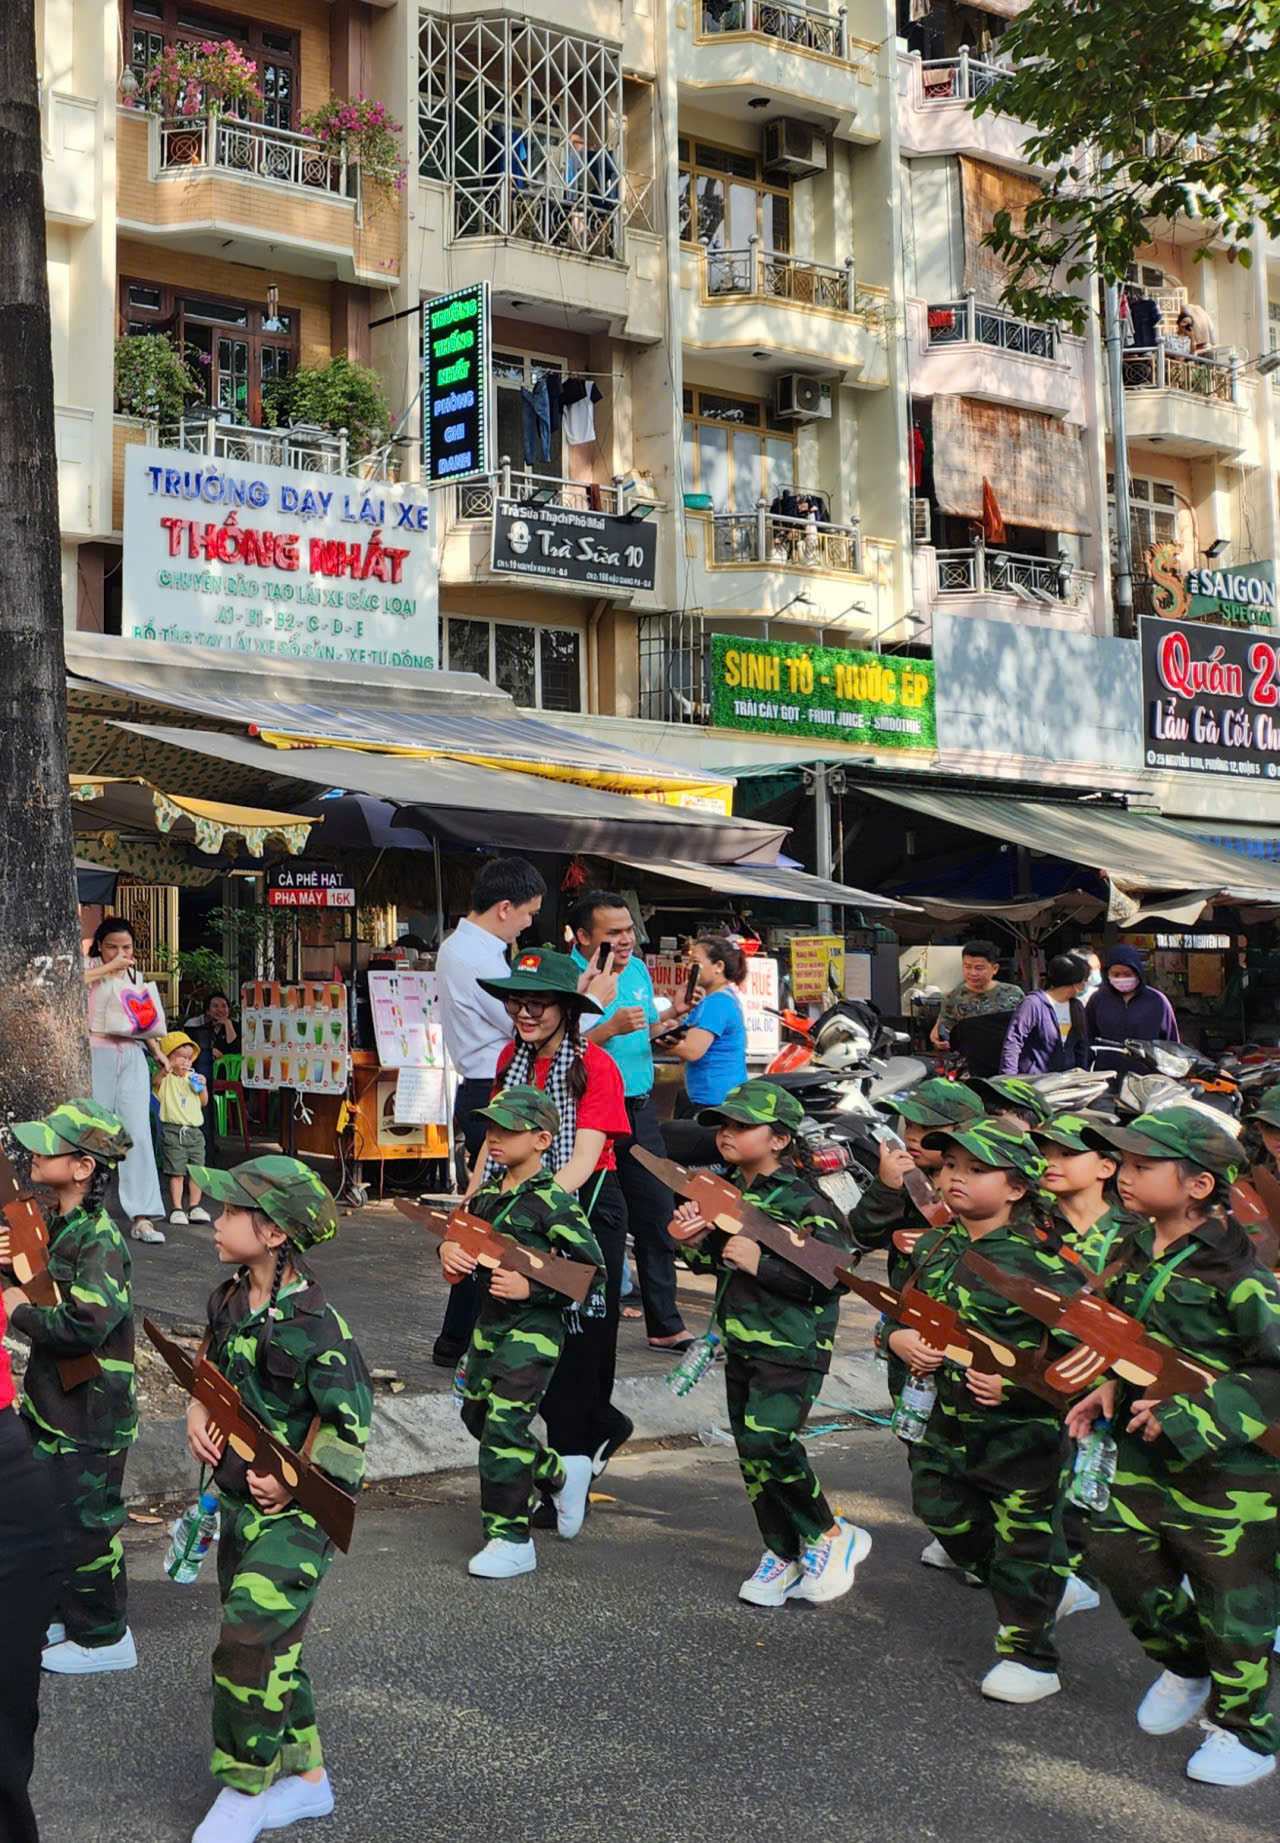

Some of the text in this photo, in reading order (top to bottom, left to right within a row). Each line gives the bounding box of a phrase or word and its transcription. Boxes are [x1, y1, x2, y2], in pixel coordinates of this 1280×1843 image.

[431, 299, 477, 329] TRƯỜNG
[433, 329, 474, 357] THỐNG
[434, 391, 474, 416] PHÒNG
[444, 423, 465, 443] GHI
[438, 452, 471, 474] DANH
[146, 464, 429, 531] TRƯỜNG DẠY LÁI XE
[586, 518, 605, 530] Mai
[161, 511, 411, 583] THỐNG NHẤT
[535, 530, 644, 568] Trà Sữa 10
[159, 568, 220, 593] CHUYÊN
[325, 590, 344, 607] XE
[384, 597, 417, 619] LOẠI
[1200, 568, 1276, 608] SAIGON
[277, 612, 295, 629] B2
[308, 615, 321, 633] C
[332, 618, 345, 635] D
[355, 621, 365, 638] E
[725, 650, 780, 691] SINH
[785, 648, 814, 694] TỐ
[834, 660, 897, 705] NƯỚC
[901, 665, 929, 708] ÉP
[1157, 631, 1280, 707] Quán 2
[733, 699, 758, 718] TRÁI
[759, 702, 778, 719] CÂY
[781, 707, 801, 724] GỌT
[808, 709, 836, 724] FRUIT
[837, 711, 864, 728] JUICE
[873, 716, 922, 734] SMOOTHIE
[1156, 697, 1189, 740] Lẩu
[1194, 706, 1220, 744] Gà
[1223, 707, 1253, 748] Cốt
[278, 870, 344, 889] CÀ PHÊ HẠT
[274, 892, 297, 904] PHA
[299, 890, 323, 904] MÁY
[1184, 934, 1192, 948] 23
